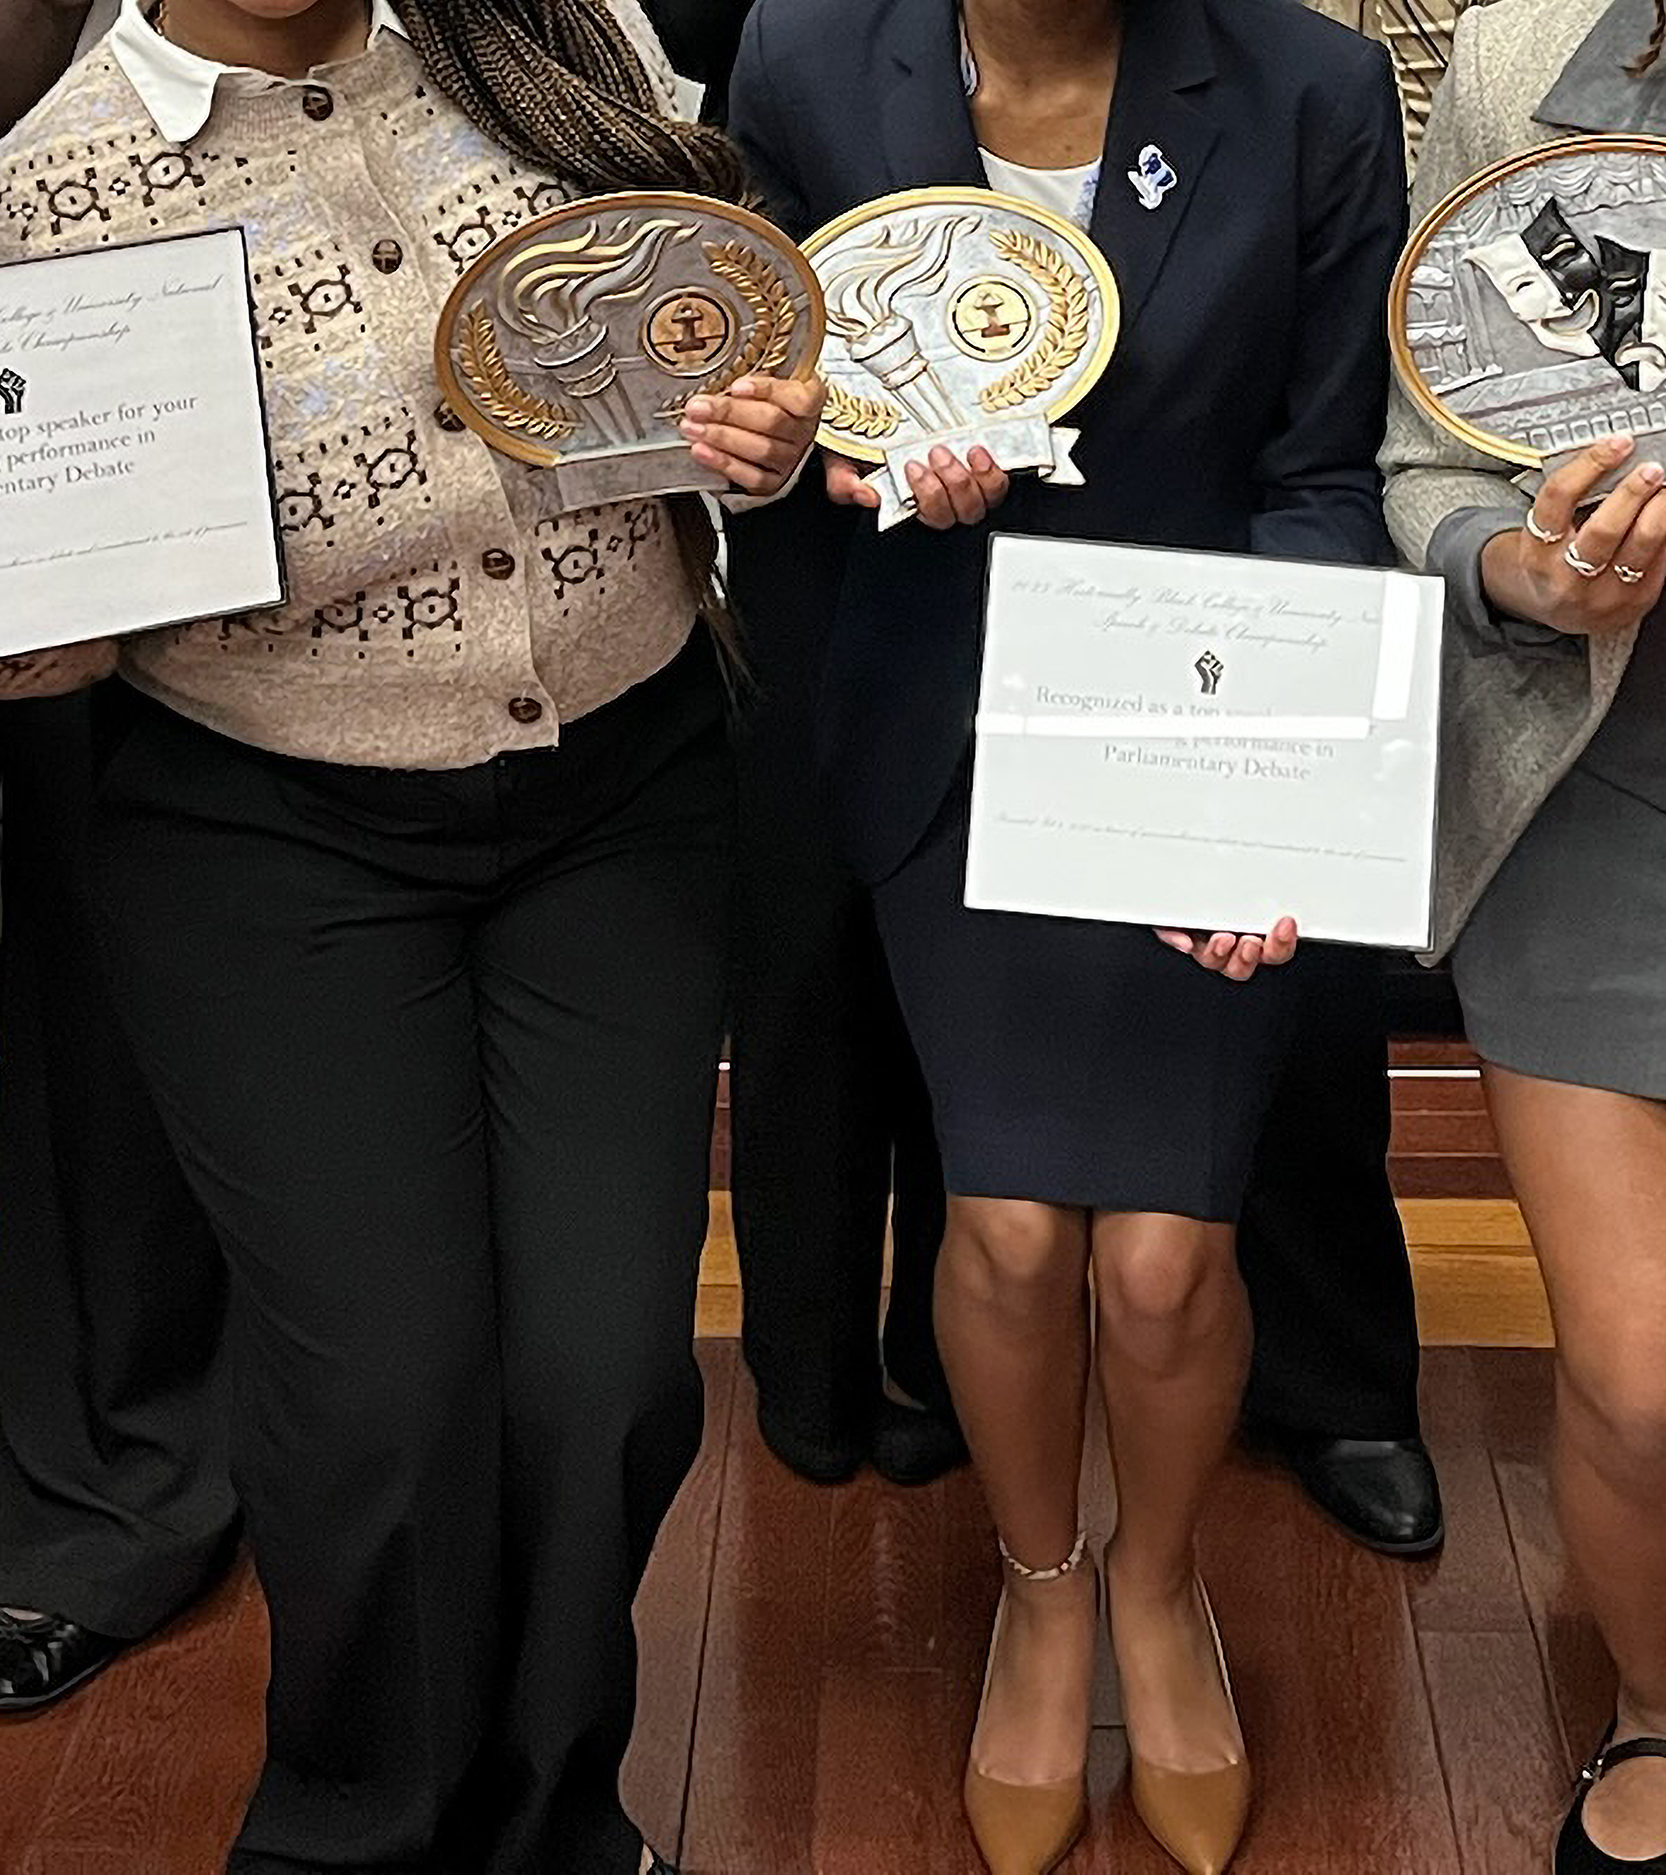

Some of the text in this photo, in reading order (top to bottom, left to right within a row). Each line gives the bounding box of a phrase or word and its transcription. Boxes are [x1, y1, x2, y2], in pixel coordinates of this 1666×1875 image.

[36, 408, 113, 439] speaker
[117, 403, 146, 422] for
[152, 396, 199, 423] your
[6, 434, 133, 474] performance
[137, 428, 157, 446] in
[65, 460, 136, 484] Debate
[1036, 685, 1143, 714] Recognized
[1148, 700, 1169, 716] as
[1173, 704, 1184, 716] a
[1104, 744, 1311, 782] Parliamentary Debate
[1316, 743, 1335, 759] in
